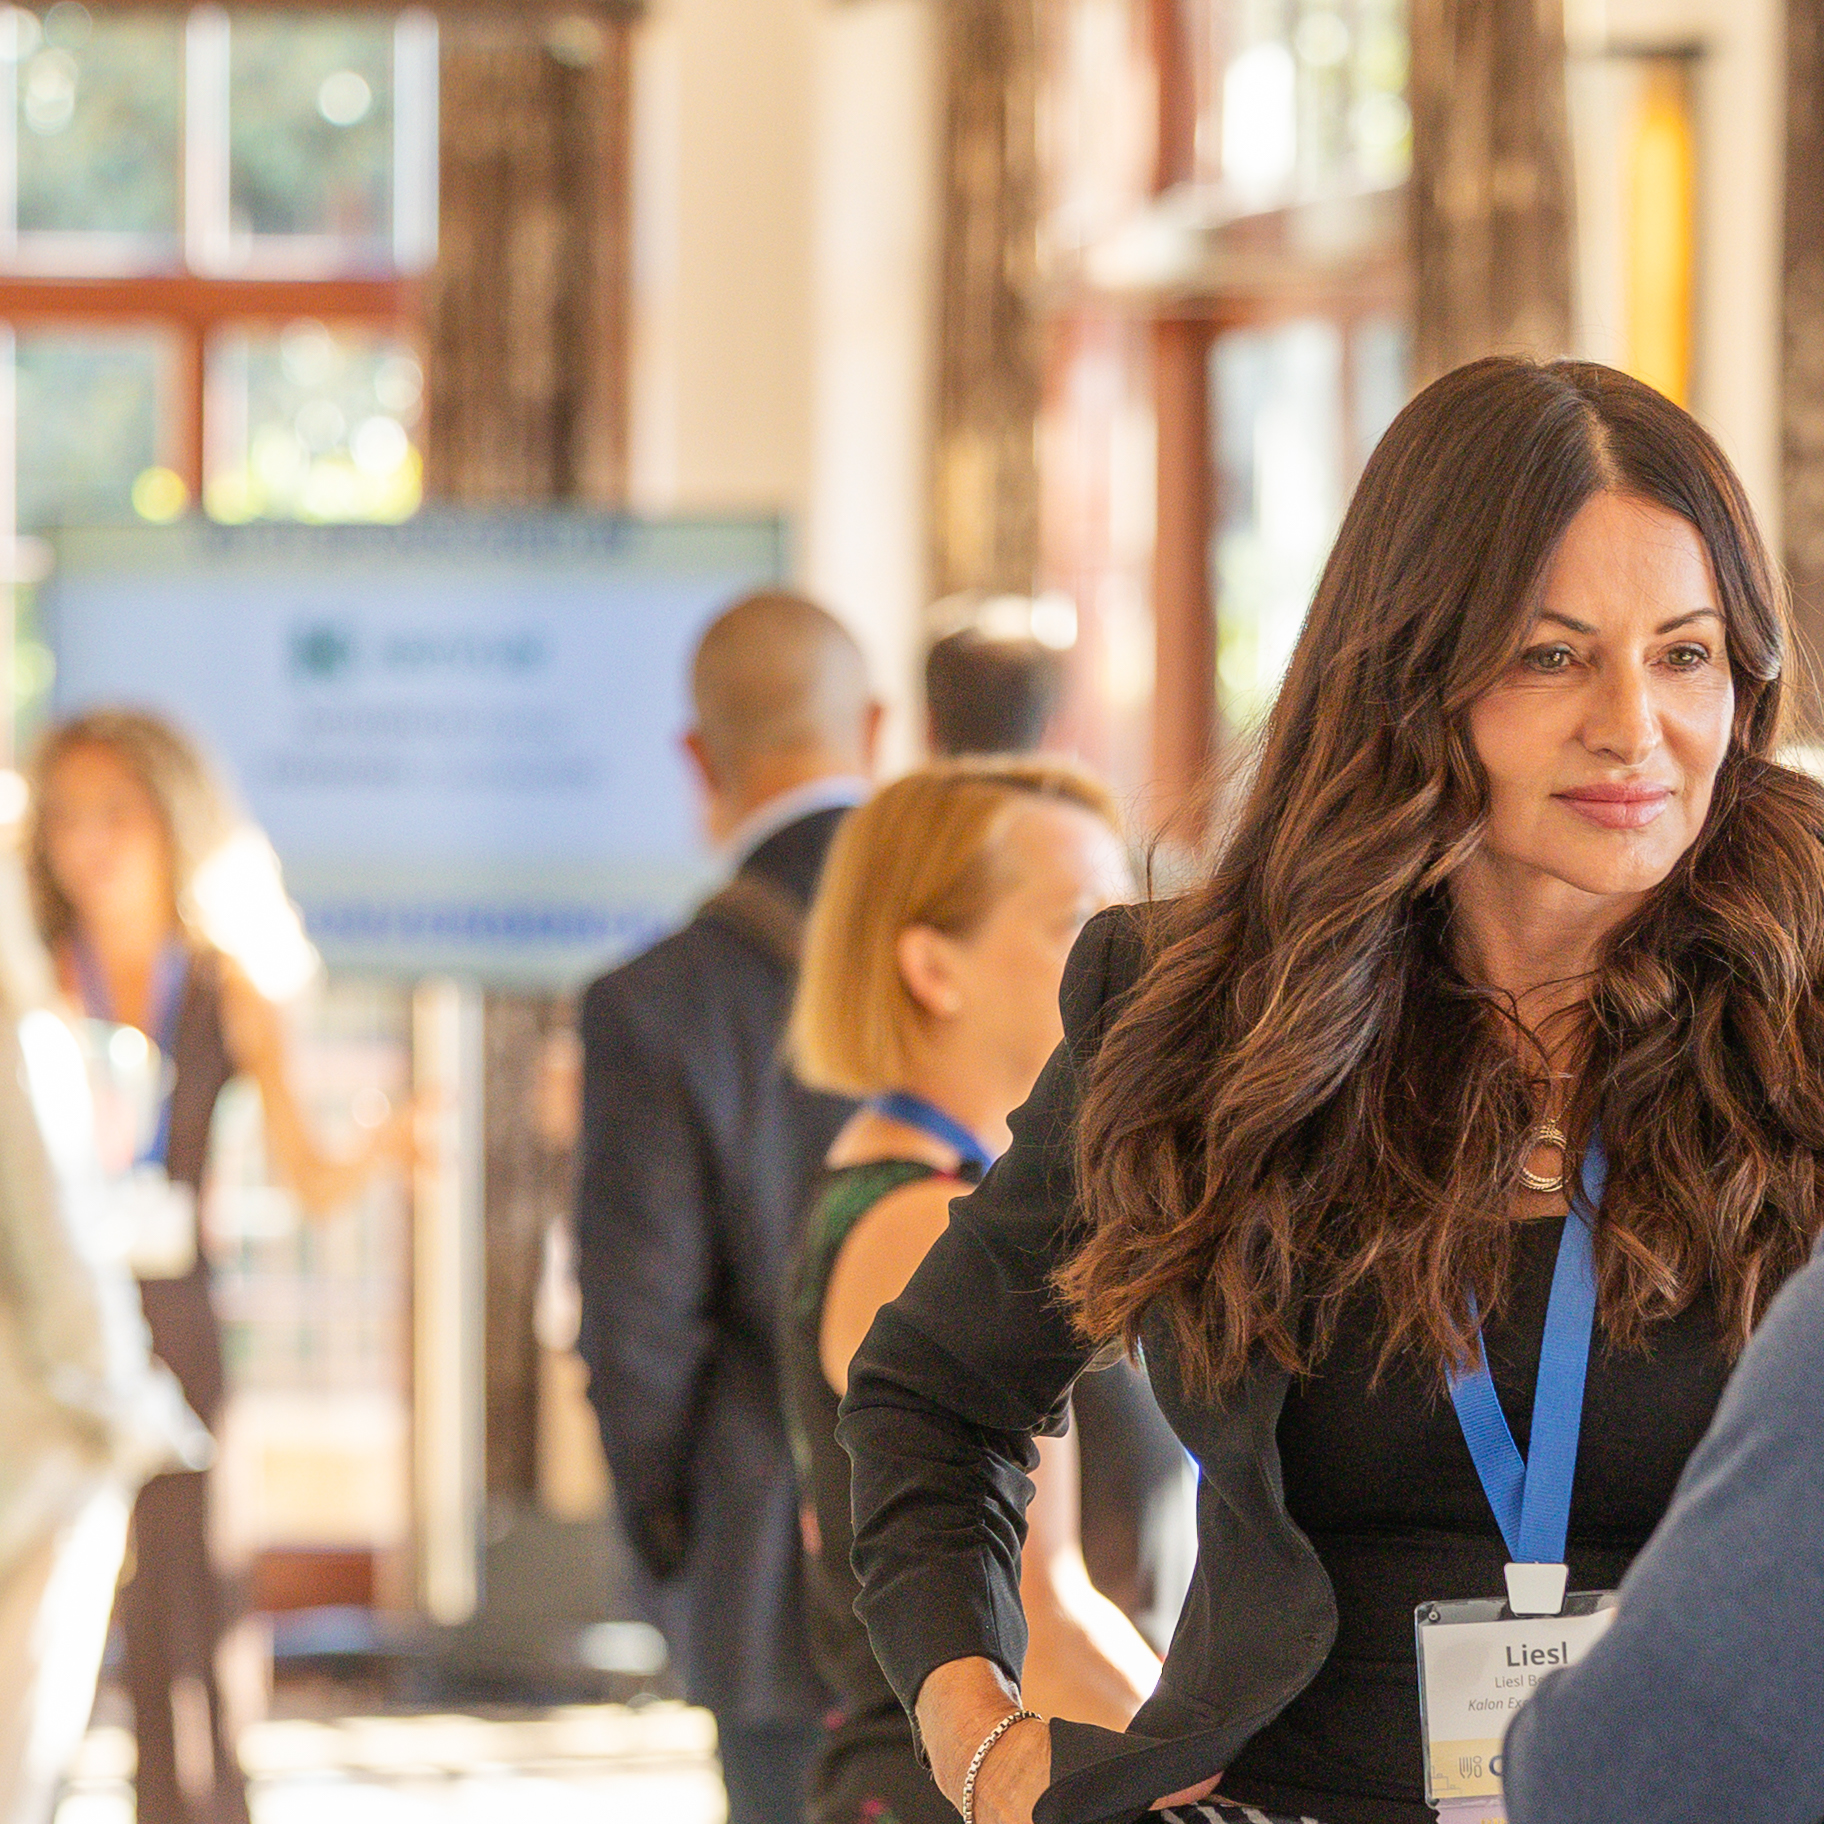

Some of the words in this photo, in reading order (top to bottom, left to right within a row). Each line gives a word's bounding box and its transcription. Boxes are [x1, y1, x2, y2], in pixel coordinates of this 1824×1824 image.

[1506, 1641, 1568, 1667] Liesl
[1495, 1674, 1524, 1688] Liesl
[1468, 1698, 1504, 1711] Kalon
